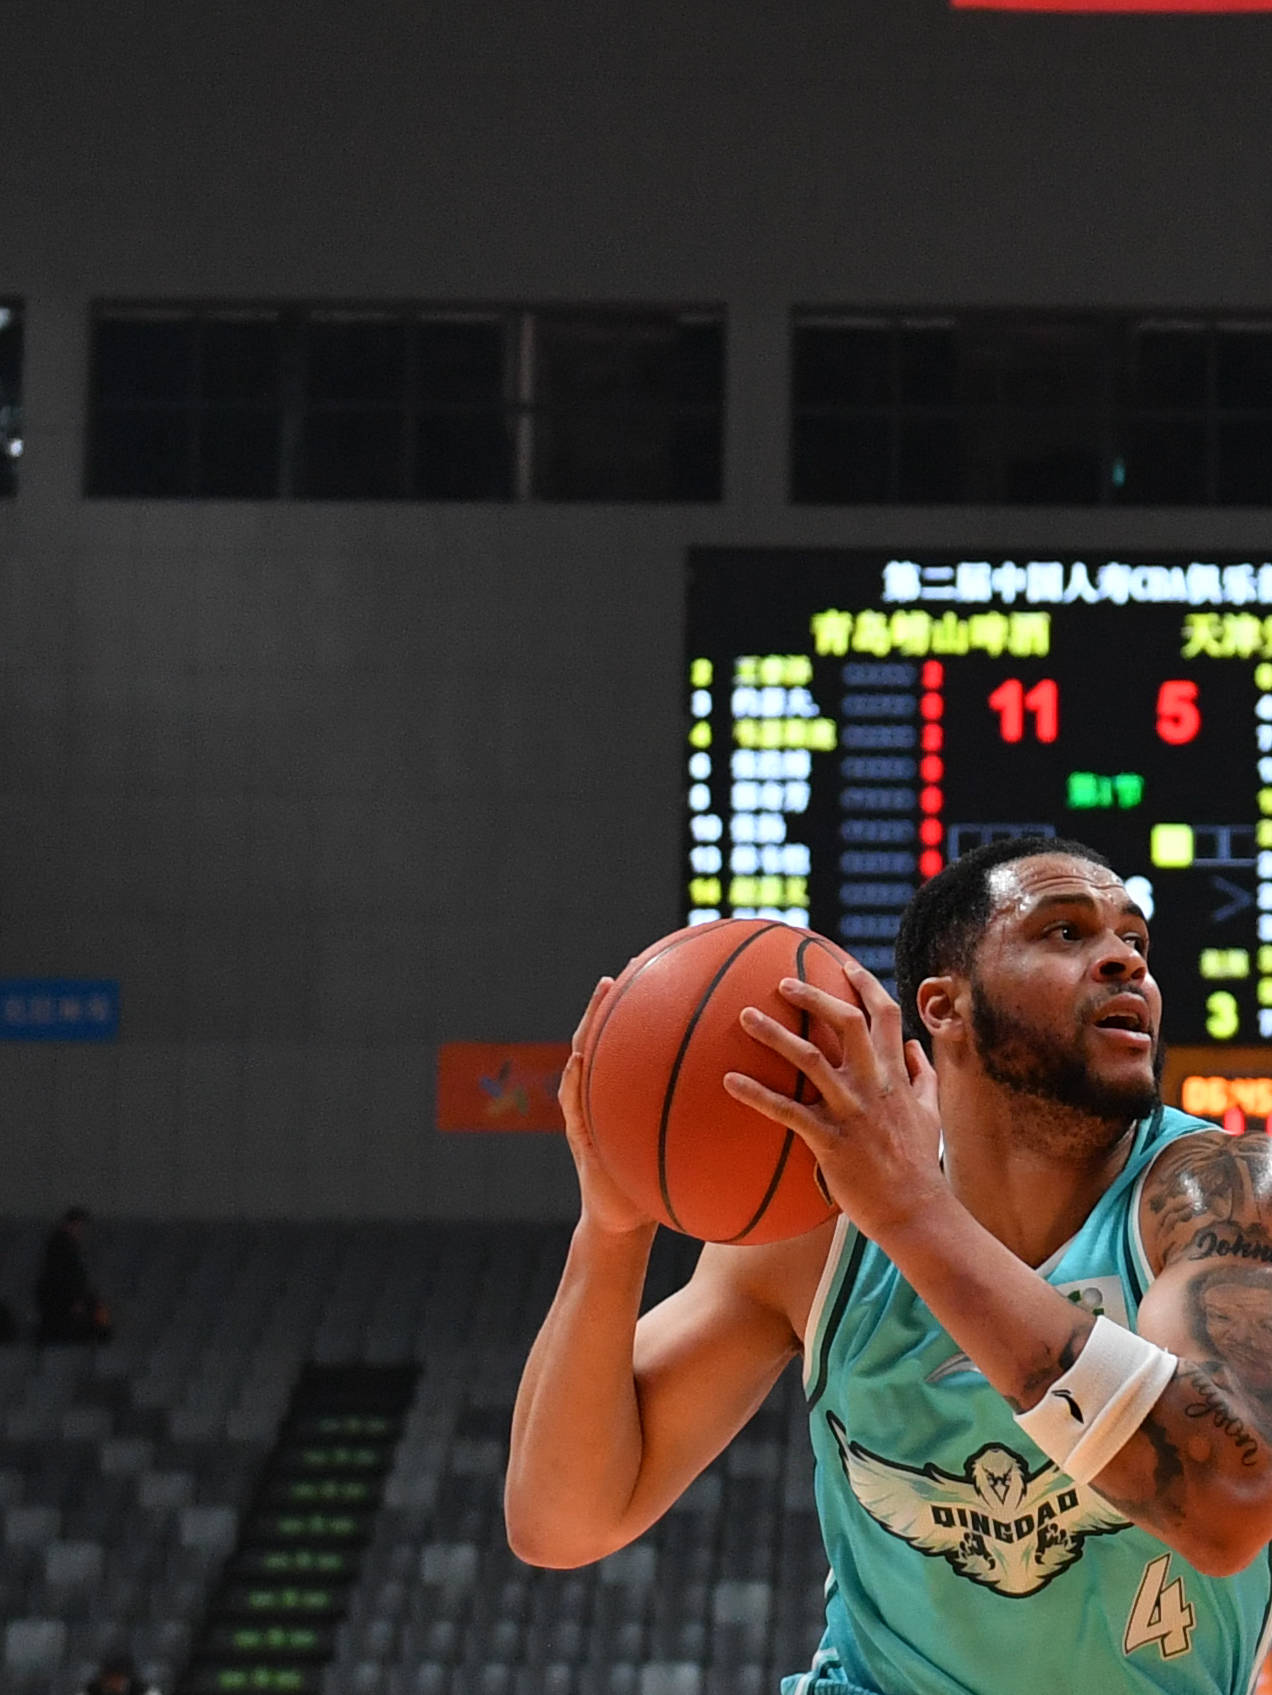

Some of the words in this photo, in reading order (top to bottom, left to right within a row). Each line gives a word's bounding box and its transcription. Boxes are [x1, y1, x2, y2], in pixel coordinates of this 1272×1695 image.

[988, 678, 1059, 744] 11
[1155, 679, 1201, 745] 5
[1206, 990, 1239, 1039] 3
[930, 1488, 1079, 1544] QINGDAO
[1122, 1551, 1196, 1660] 4
